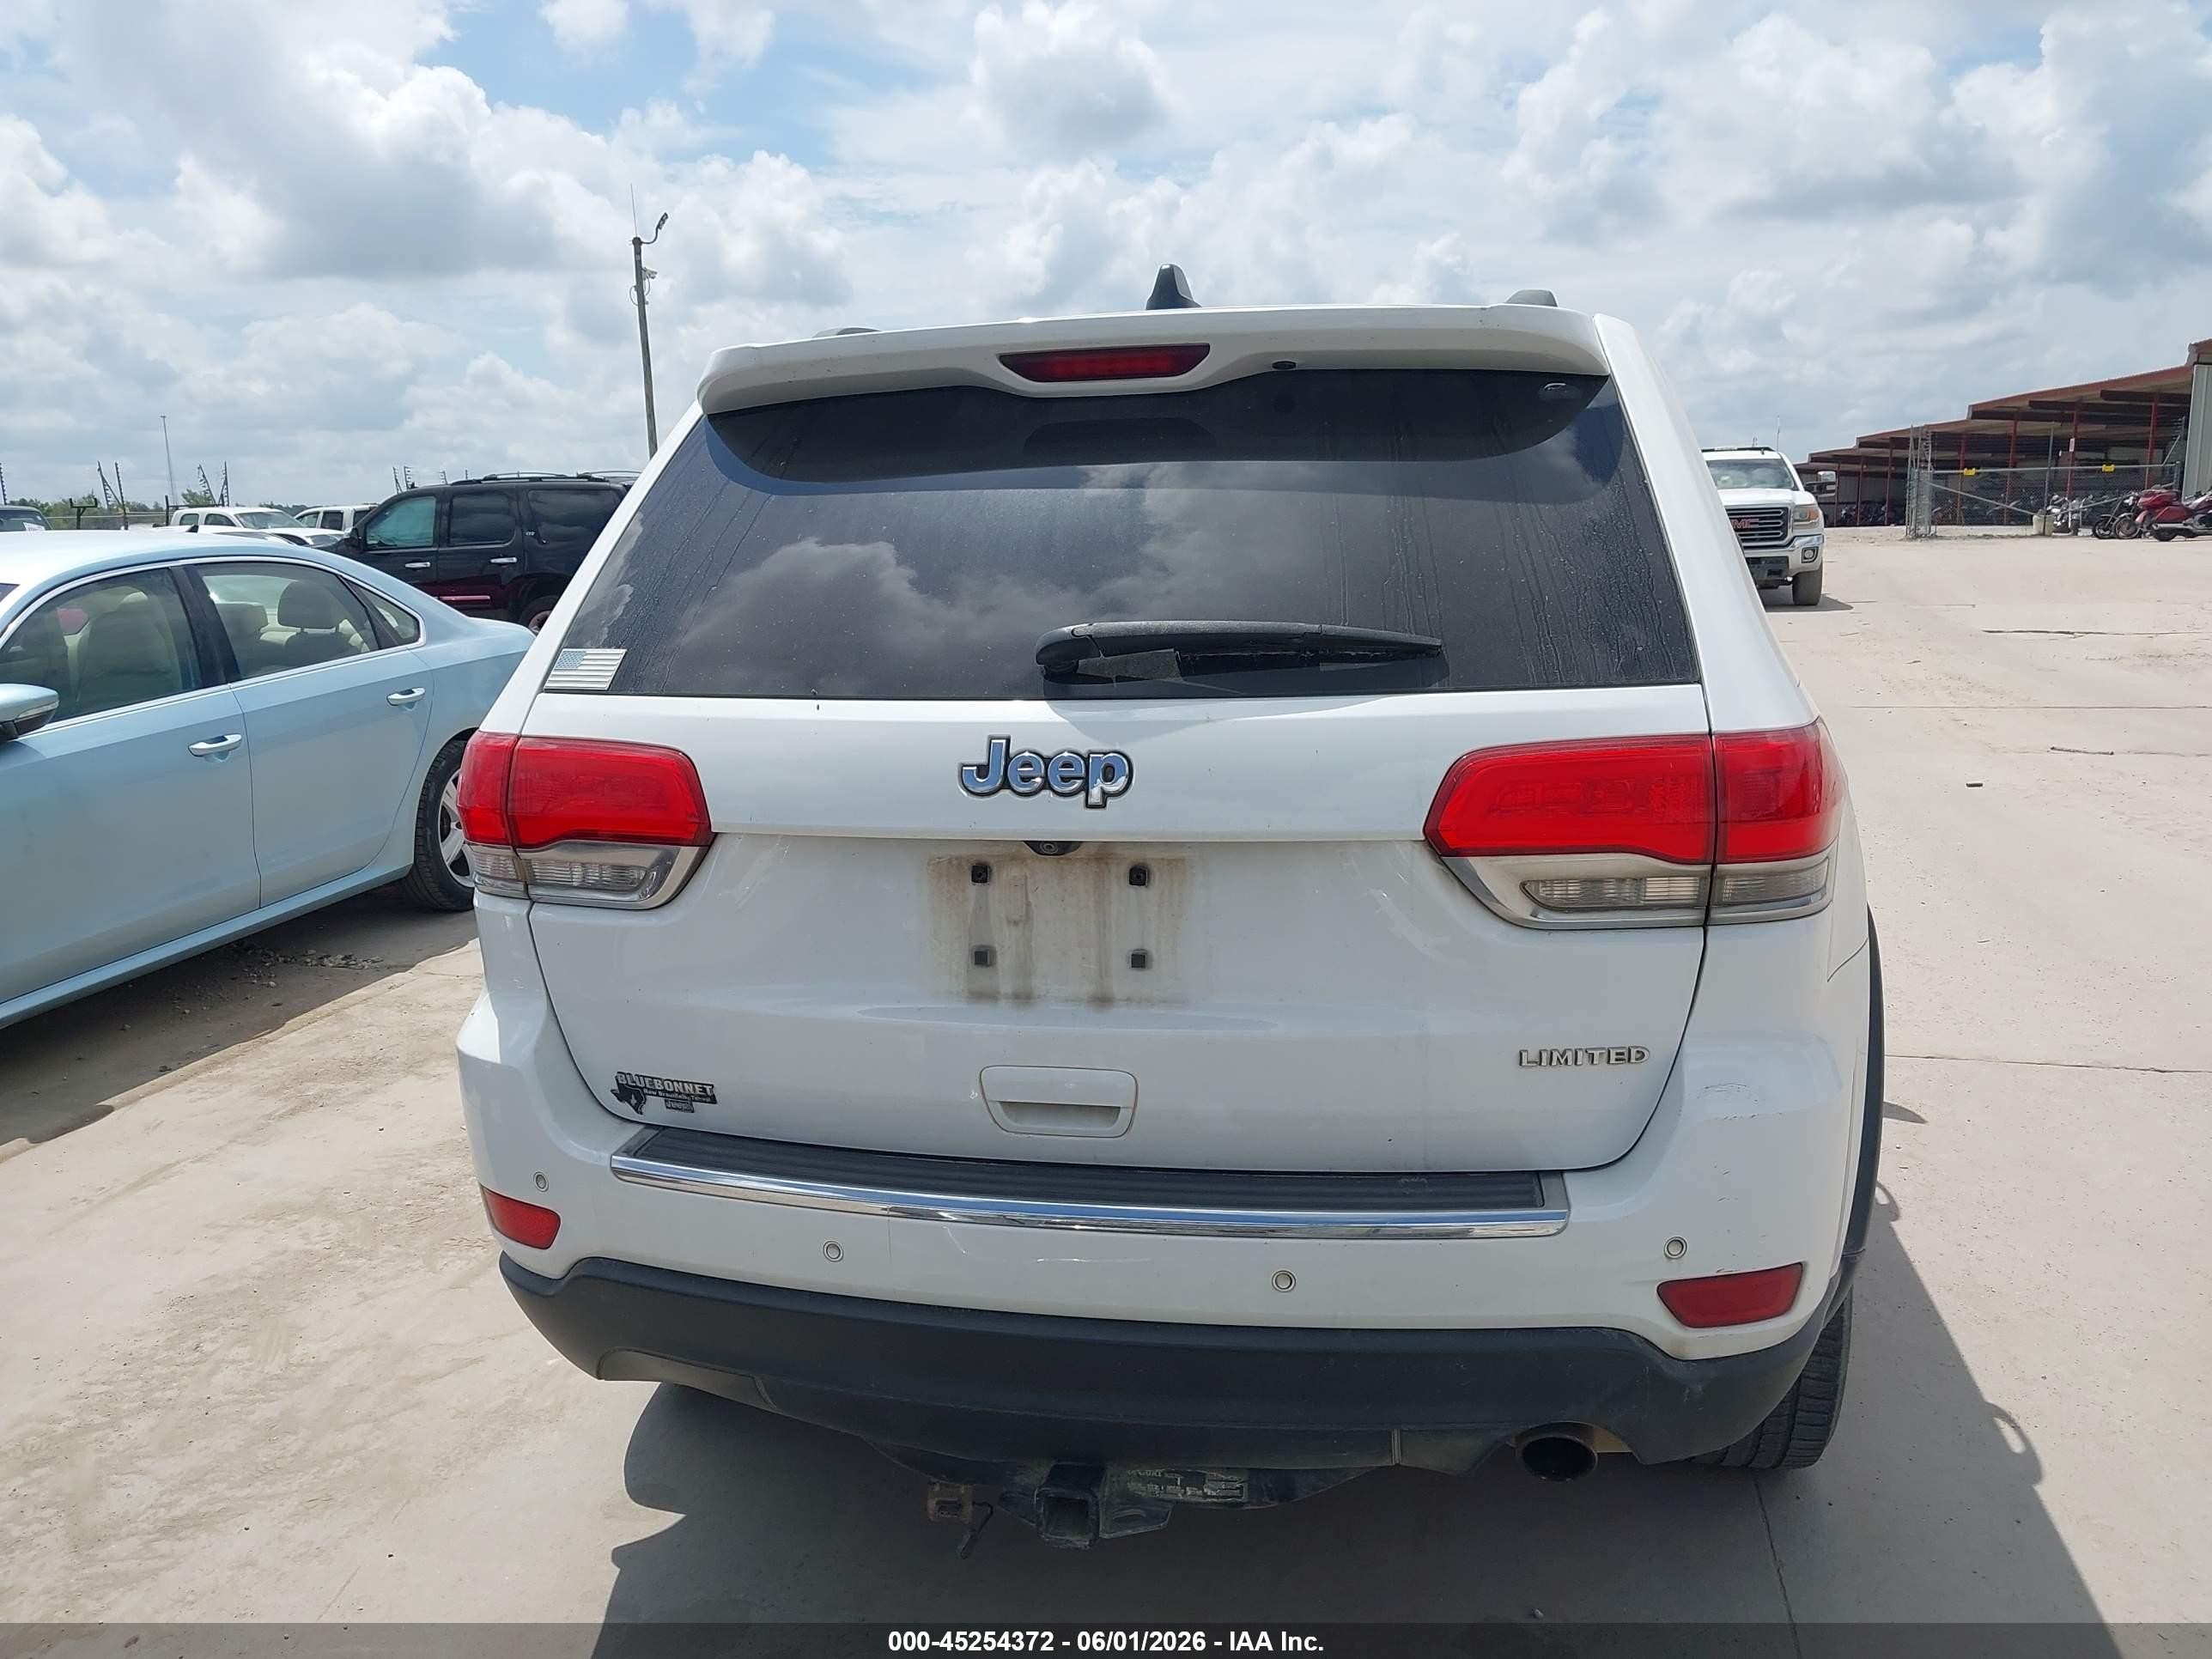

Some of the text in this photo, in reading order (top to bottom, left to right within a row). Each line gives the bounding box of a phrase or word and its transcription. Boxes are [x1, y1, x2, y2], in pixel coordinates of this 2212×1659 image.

[959, 735, 1133, 809] Jeep
[1519, 1046, 1650, 1066] LIMITED
[617, 1073, 712, 1097] BLUEBONNET
